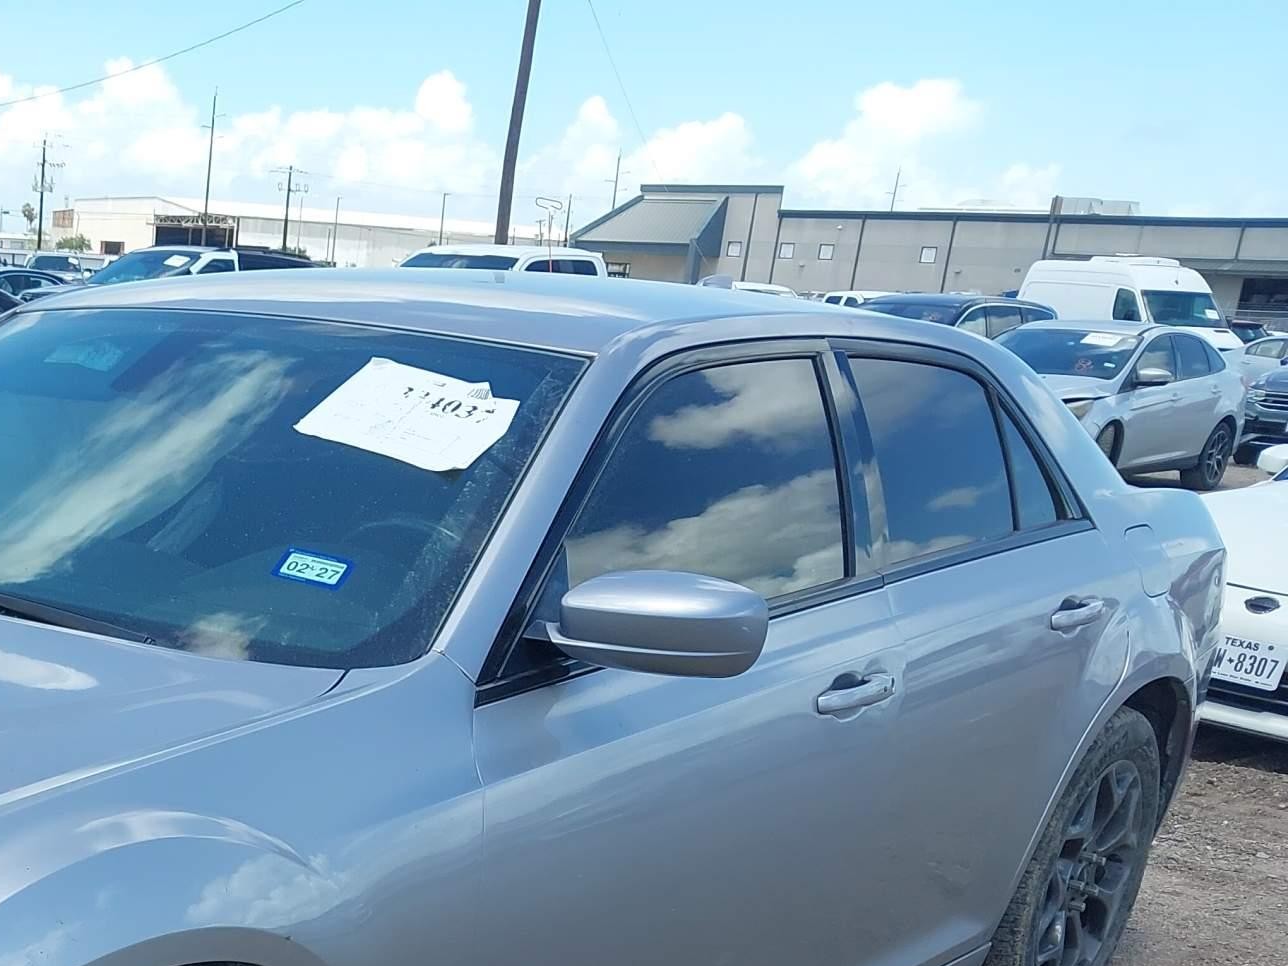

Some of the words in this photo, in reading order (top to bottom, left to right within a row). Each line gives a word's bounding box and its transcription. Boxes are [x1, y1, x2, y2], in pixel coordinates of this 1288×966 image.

[286, 561, 310, 574] 02
[315, 567, 341, 580] 27
[1224, 636, 1260, 651] TEXAS
